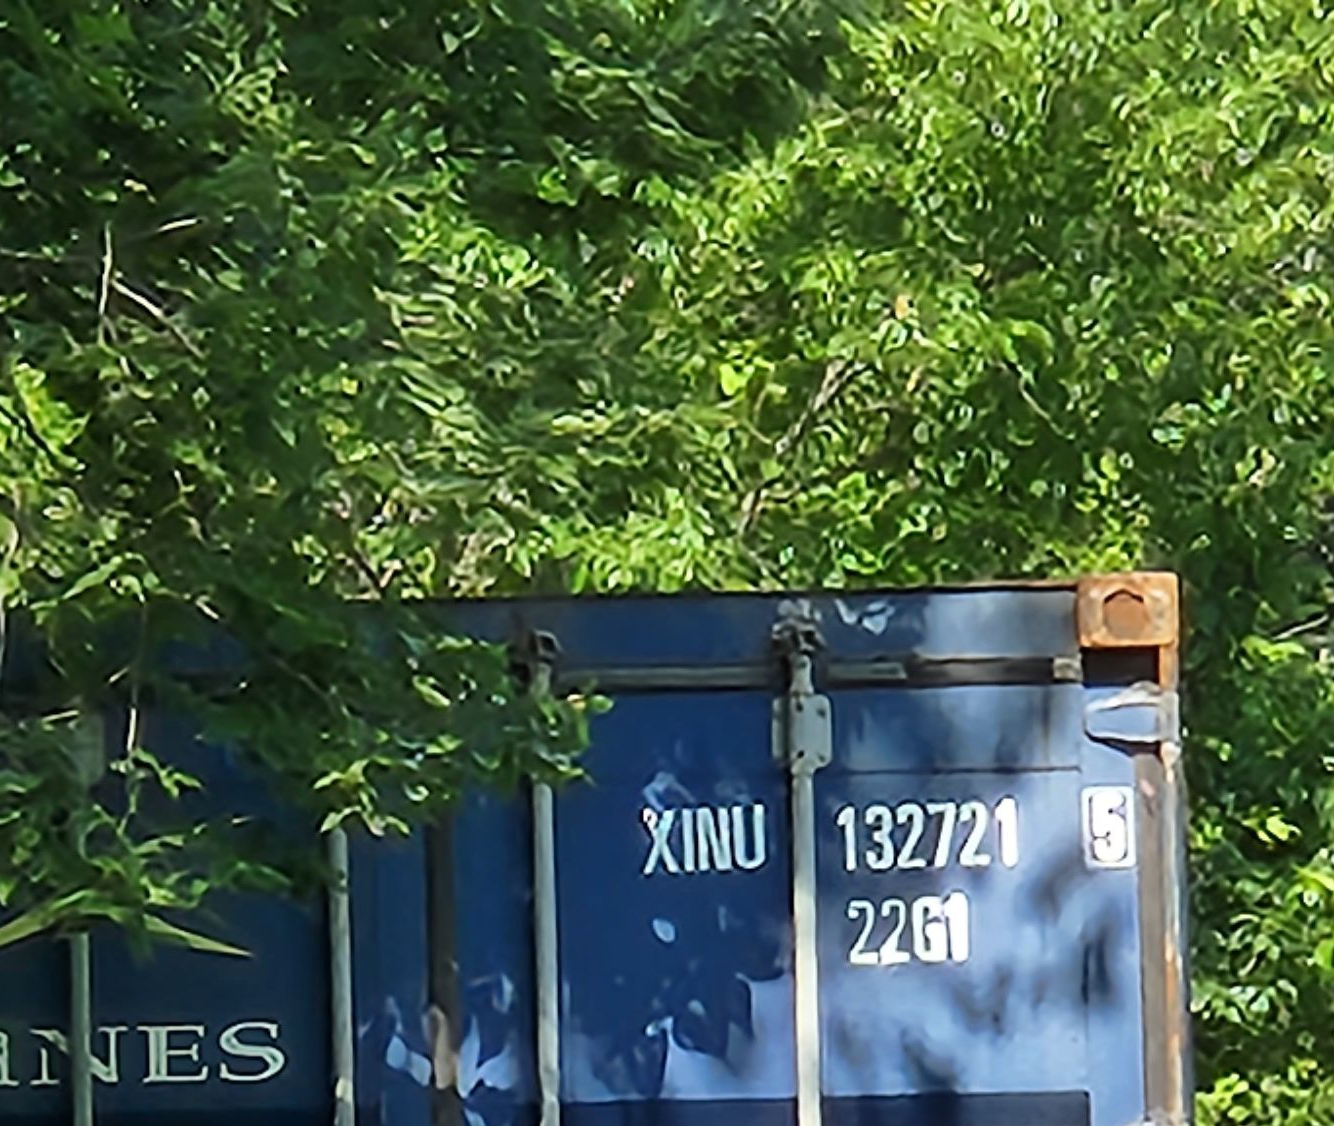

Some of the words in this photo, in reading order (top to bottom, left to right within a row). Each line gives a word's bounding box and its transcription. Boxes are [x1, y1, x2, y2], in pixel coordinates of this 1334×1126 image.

[642, 804, 765, 874] XINU
[836, 798, 1019, 871] 132721
[1091, 795, 1129, 861] 5
[848, 892, 969, 965] 22G1
